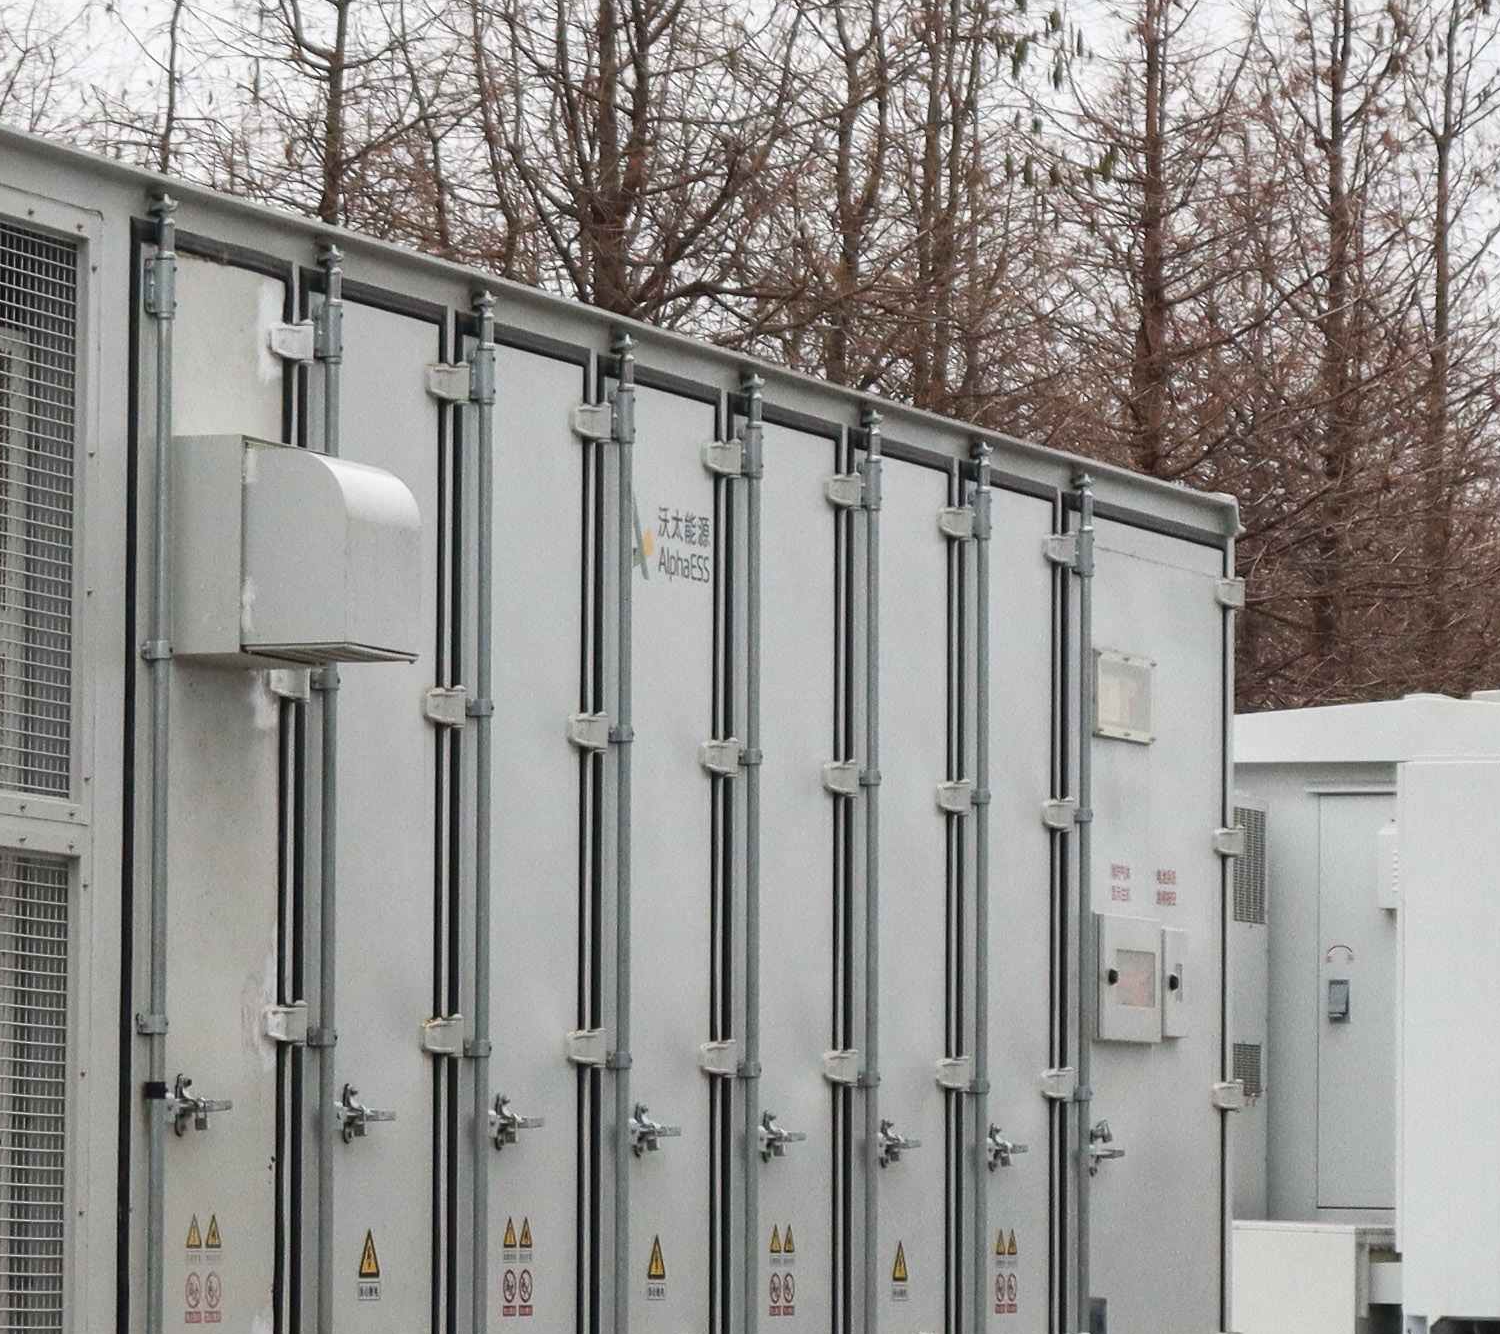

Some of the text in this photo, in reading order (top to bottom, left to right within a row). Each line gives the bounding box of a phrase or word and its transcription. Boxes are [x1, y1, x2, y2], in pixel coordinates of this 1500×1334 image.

[658, 507, 711, 548] 沃太能源
[658, 546, 711, 584] AlphaESS
